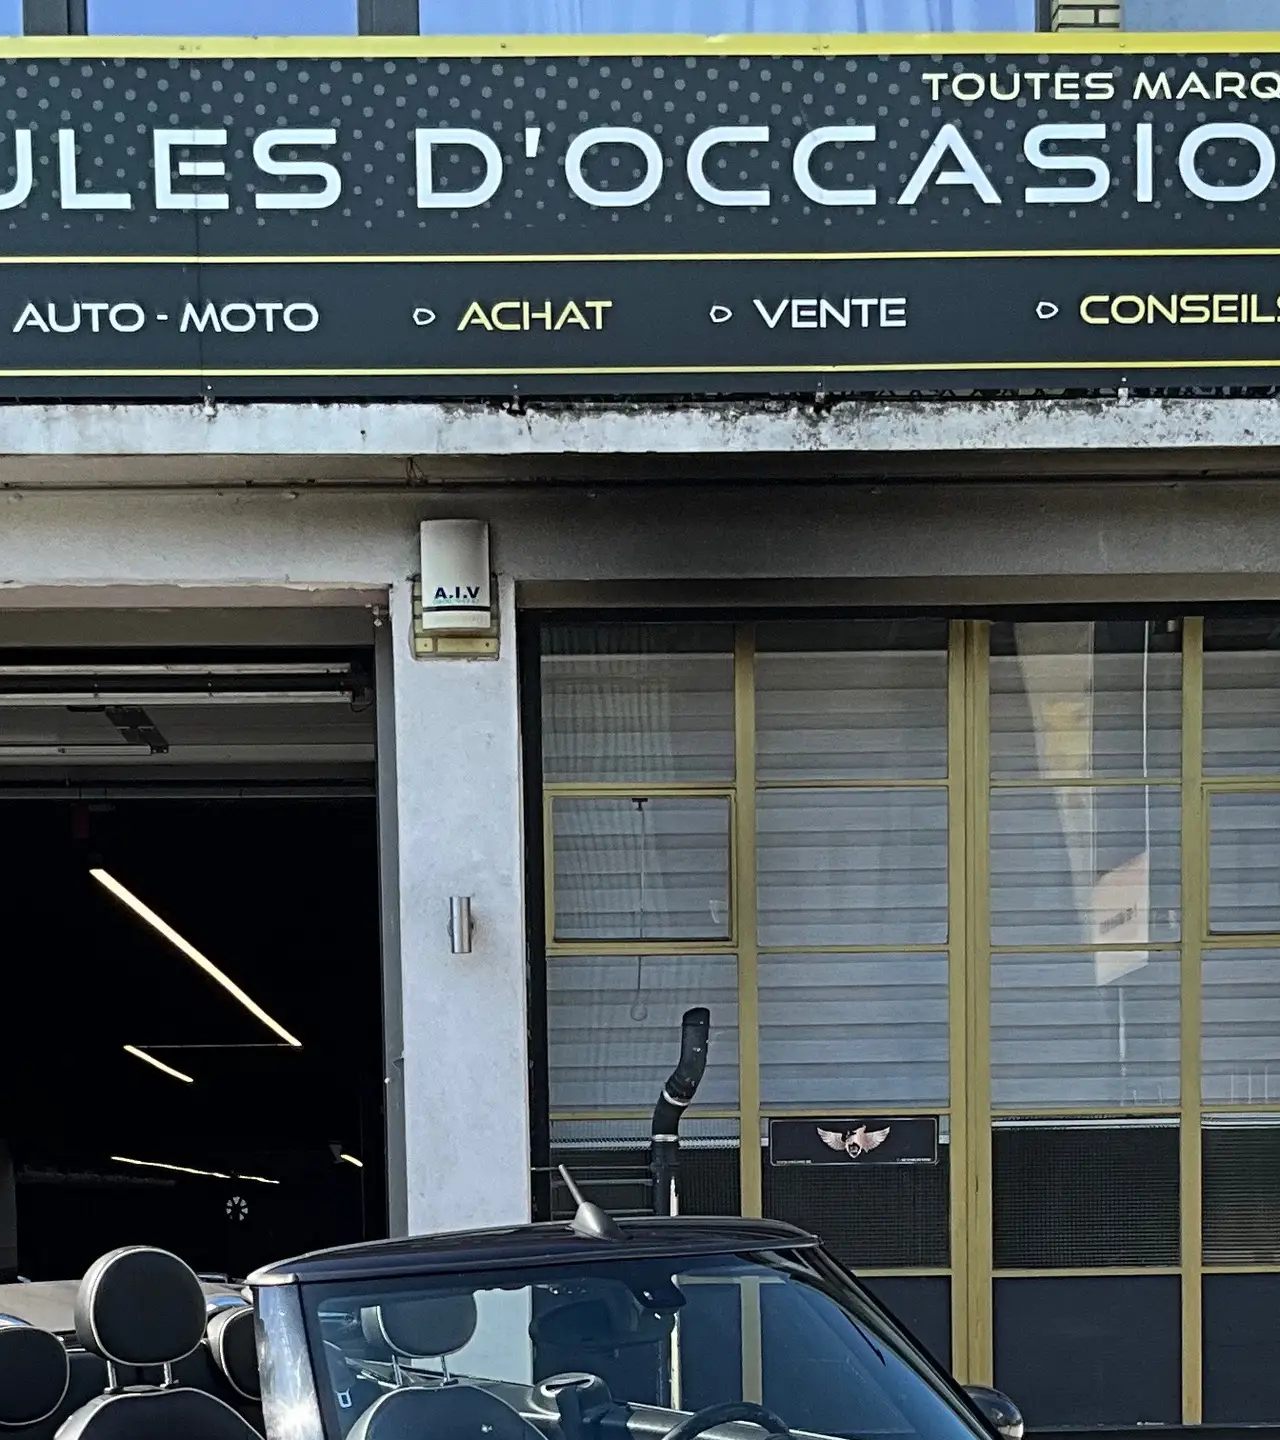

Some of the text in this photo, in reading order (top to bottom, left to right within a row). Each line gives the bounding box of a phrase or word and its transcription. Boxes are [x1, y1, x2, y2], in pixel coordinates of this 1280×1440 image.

[922, 72, 1114, 101] TOUTES
[12, 302, 145, 333] AUTO
[179, 302, 319, 333] MOTO
[457, 300, 613, 331] ACHAT
[752, 297, 907, 329] VENTE
[434, 586, 480, 599] A.I.V
